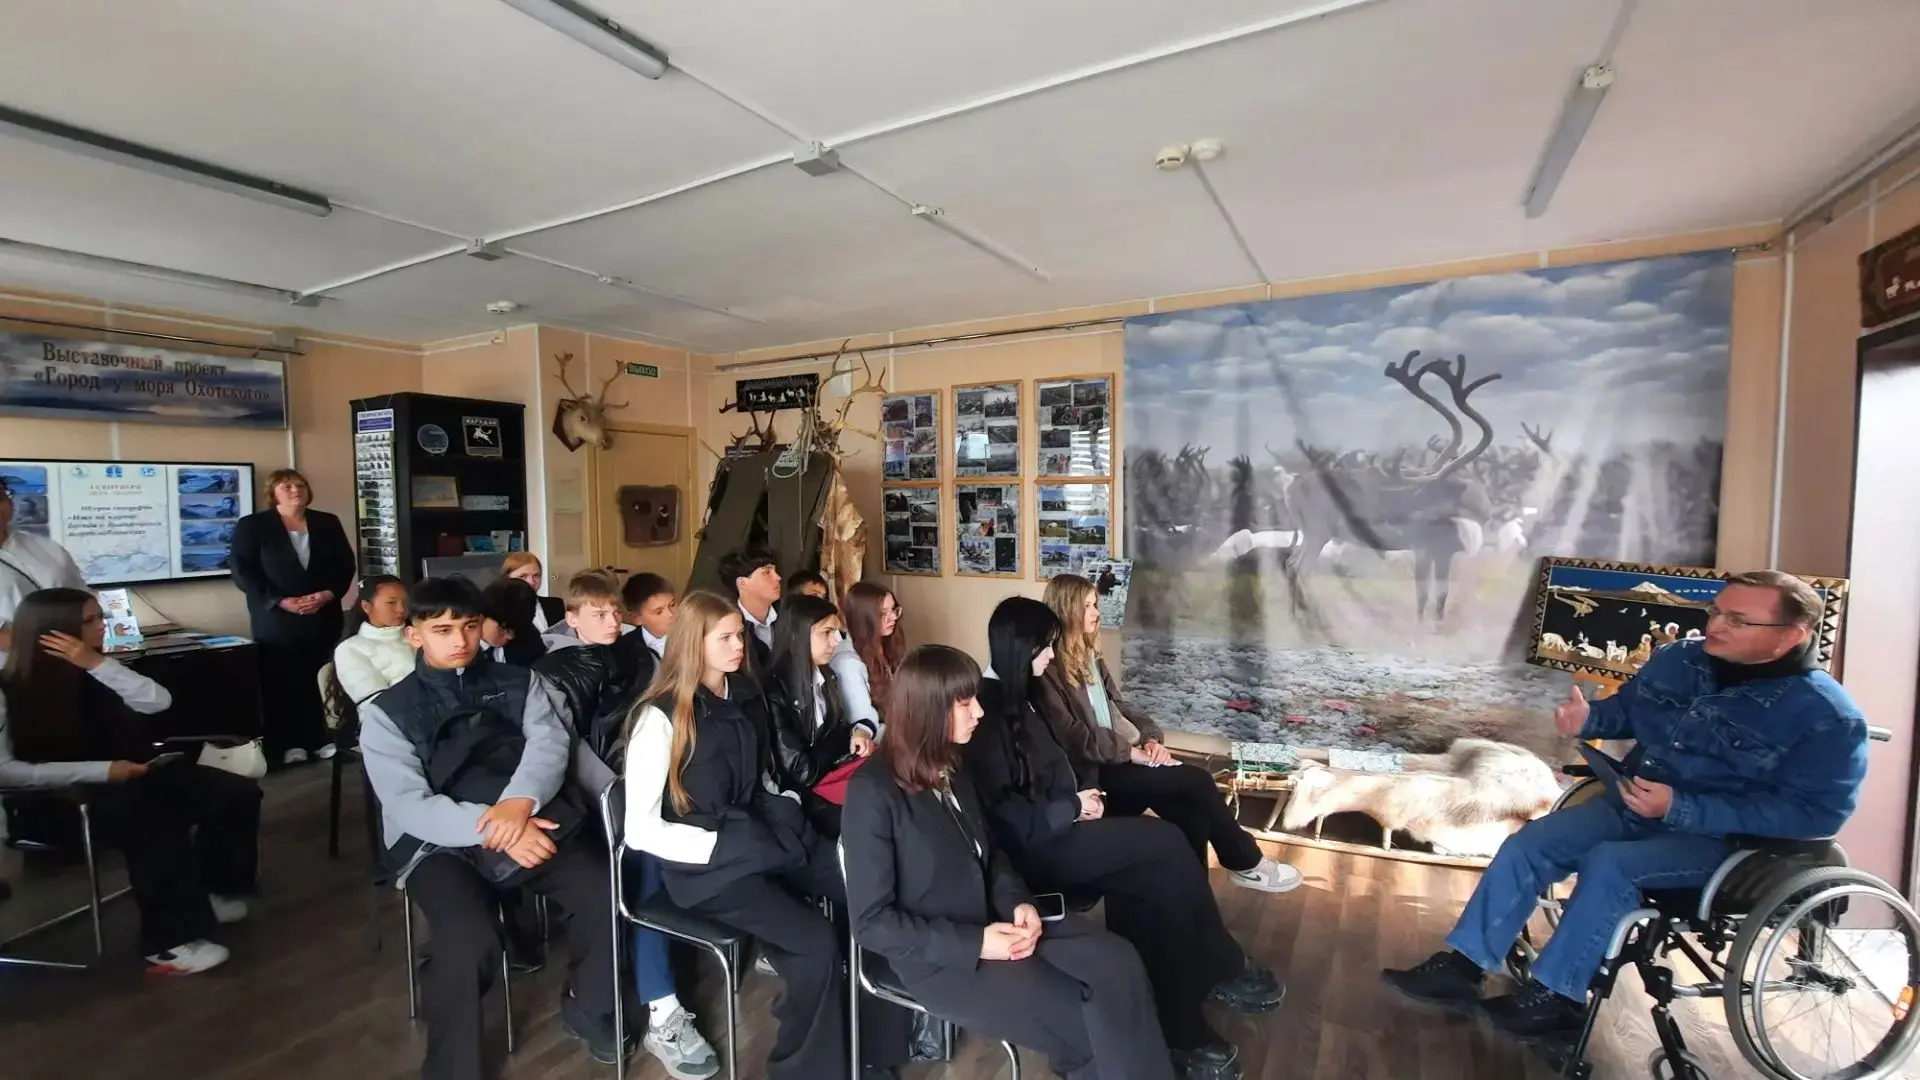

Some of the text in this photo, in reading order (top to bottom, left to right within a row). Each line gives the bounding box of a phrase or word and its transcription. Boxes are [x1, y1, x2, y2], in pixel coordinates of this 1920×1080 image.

[42, 342, 226, 377] Выставочный проект
[629, 365, 656, 376] ВЫХОД
[34, 366, 271, 400] «Город у моря Охотского»
